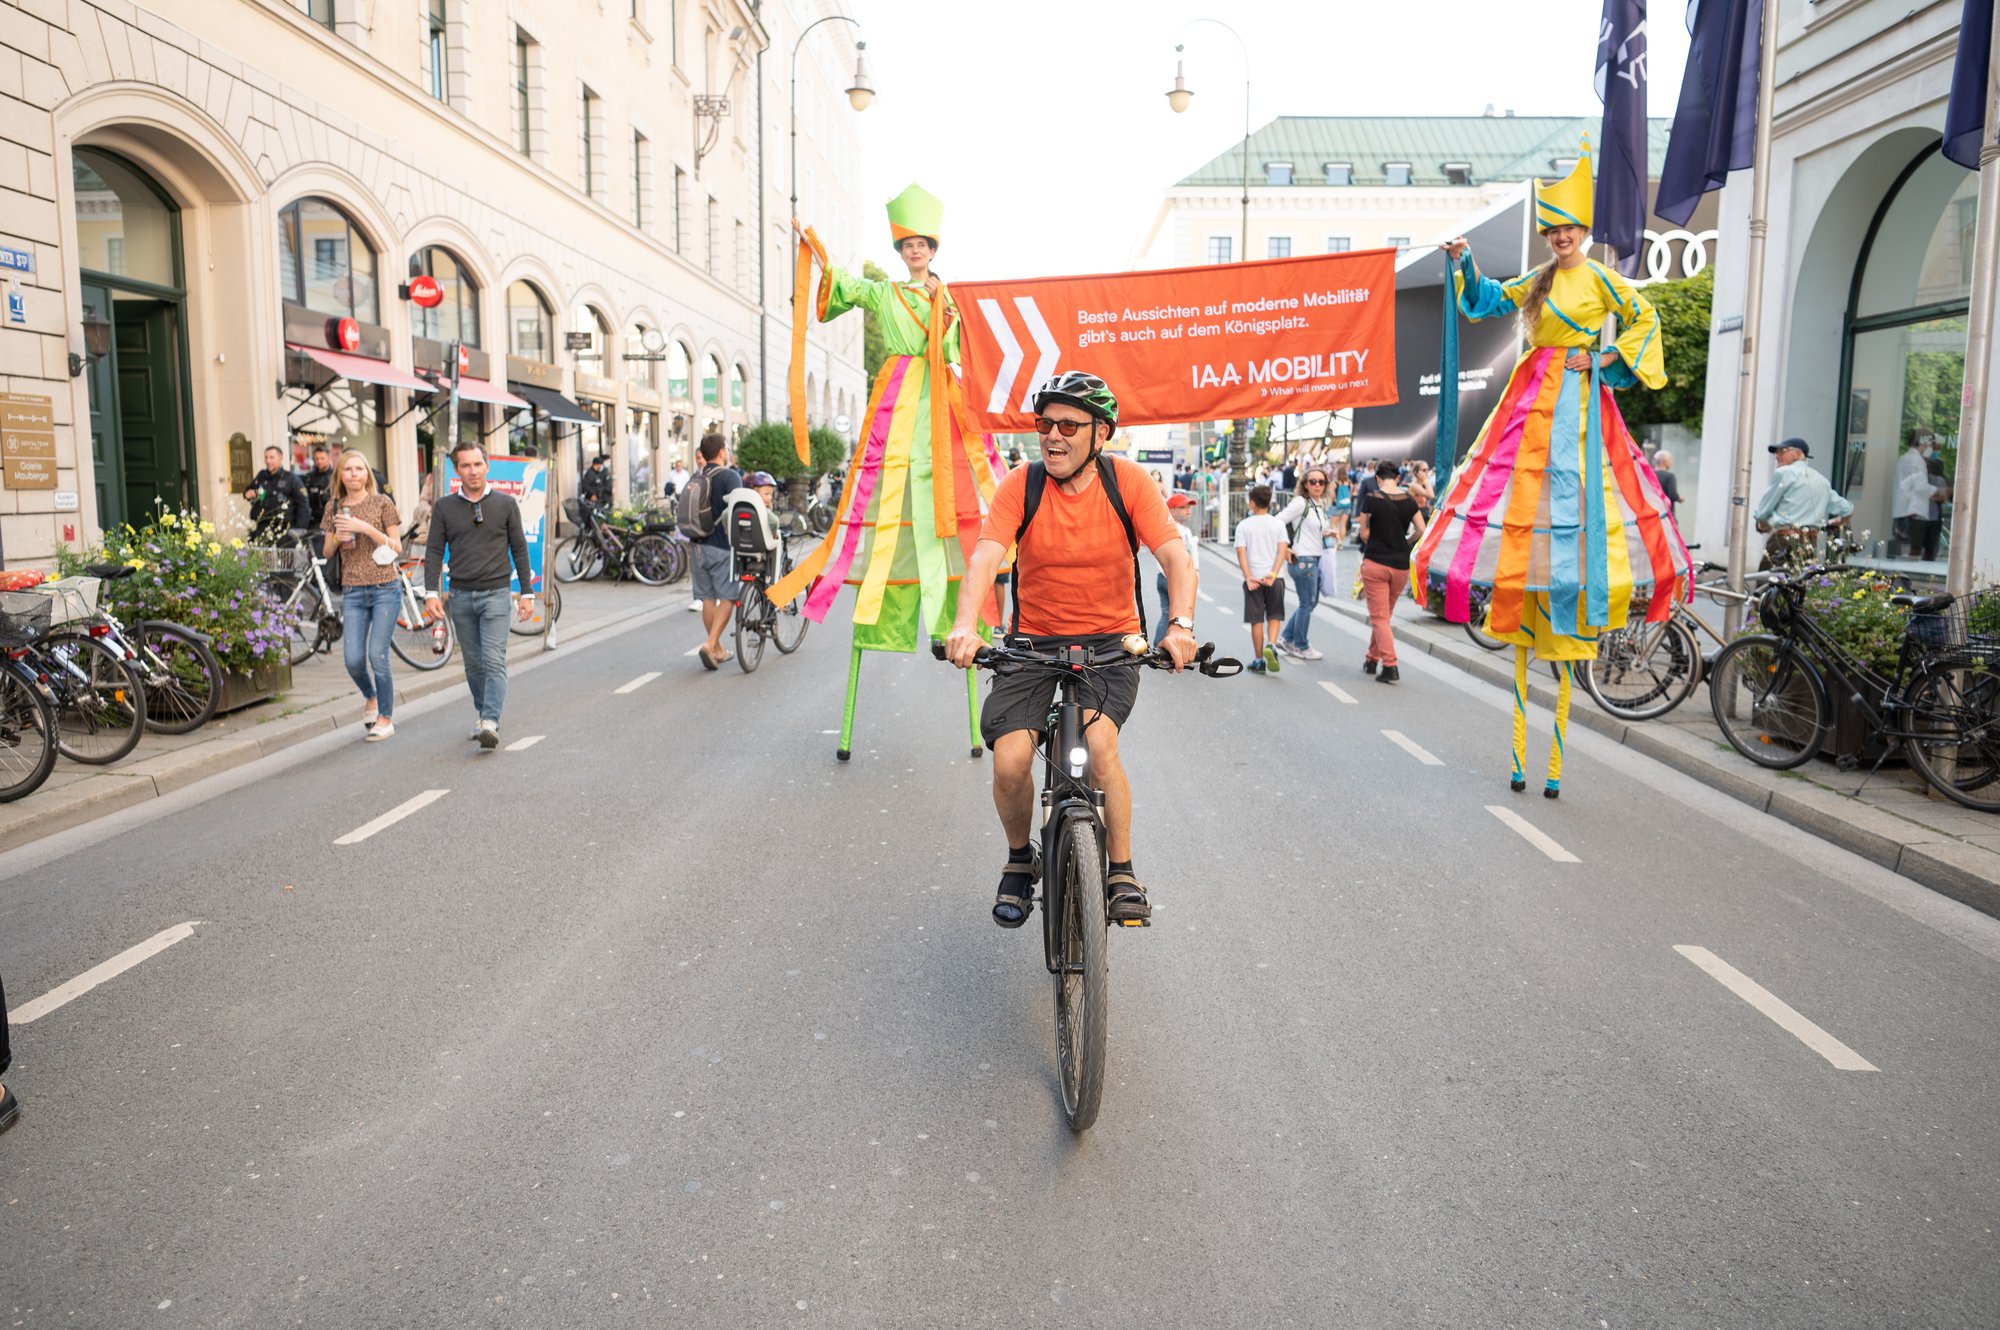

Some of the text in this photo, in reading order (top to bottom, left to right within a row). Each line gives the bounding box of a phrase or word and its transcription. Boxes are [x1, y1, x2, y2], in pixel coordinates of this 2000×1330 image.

[1077, 288, 1370, 324] Beste Aussichten auf moderne Mobilität
[1078, 315, 1310, 348] gibt's auch auf dem Königsplatz.
[1192, 349, 1369, 389] IAA MOBILITY
[1270, 378, 1369, 397] What will move us next
[20, 461, 42, 471] Galerie
